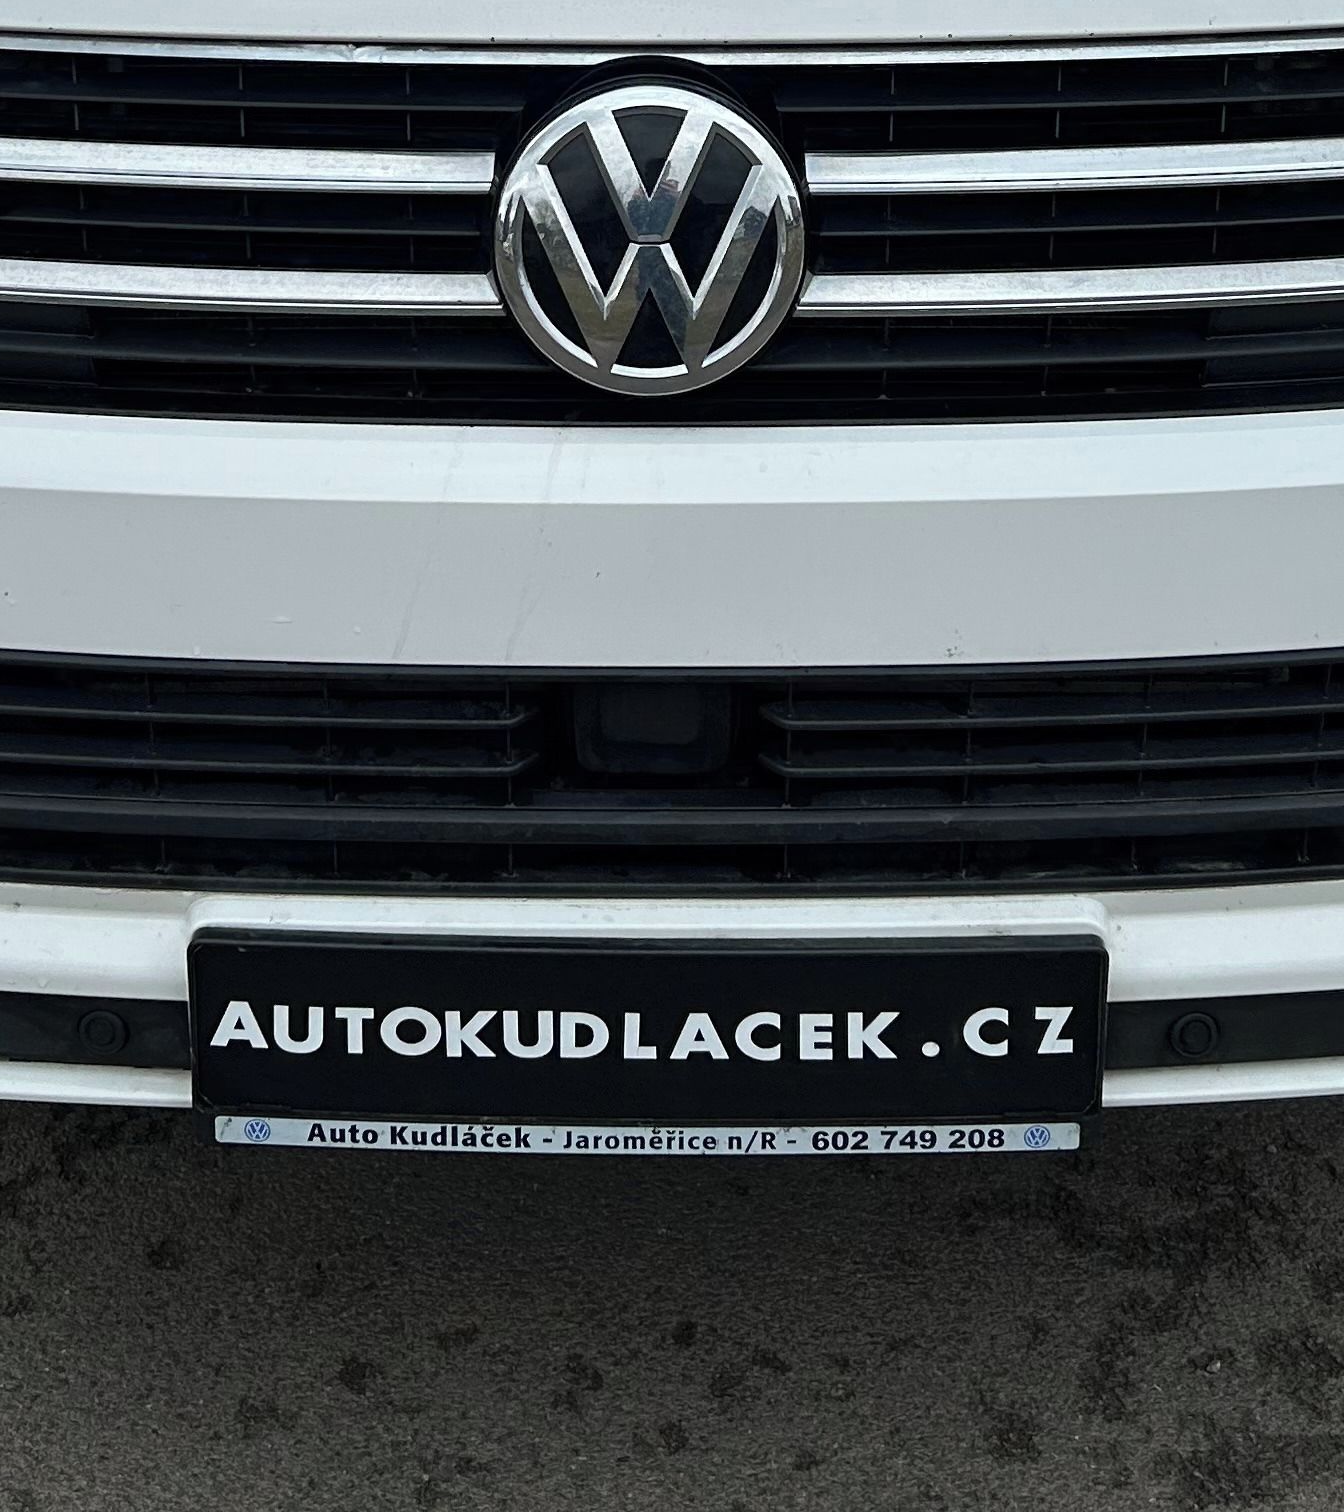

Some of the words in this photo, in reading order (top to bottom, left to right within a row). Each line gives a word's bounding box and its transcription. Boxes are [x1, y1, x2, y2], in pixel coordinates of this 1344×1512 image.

[307, 1123, 379, 1144] Auto
[390, 1124, 531, 1148] Kudláček
[563, 1127, 717, 1150] Jaroměřice
[727, 1131, 777, 1153] n/R
[811, 1130, 869, 1151] 602
[880, 1130, 937, 1150] 749
[948, 1129, 1005, 1149] 208
